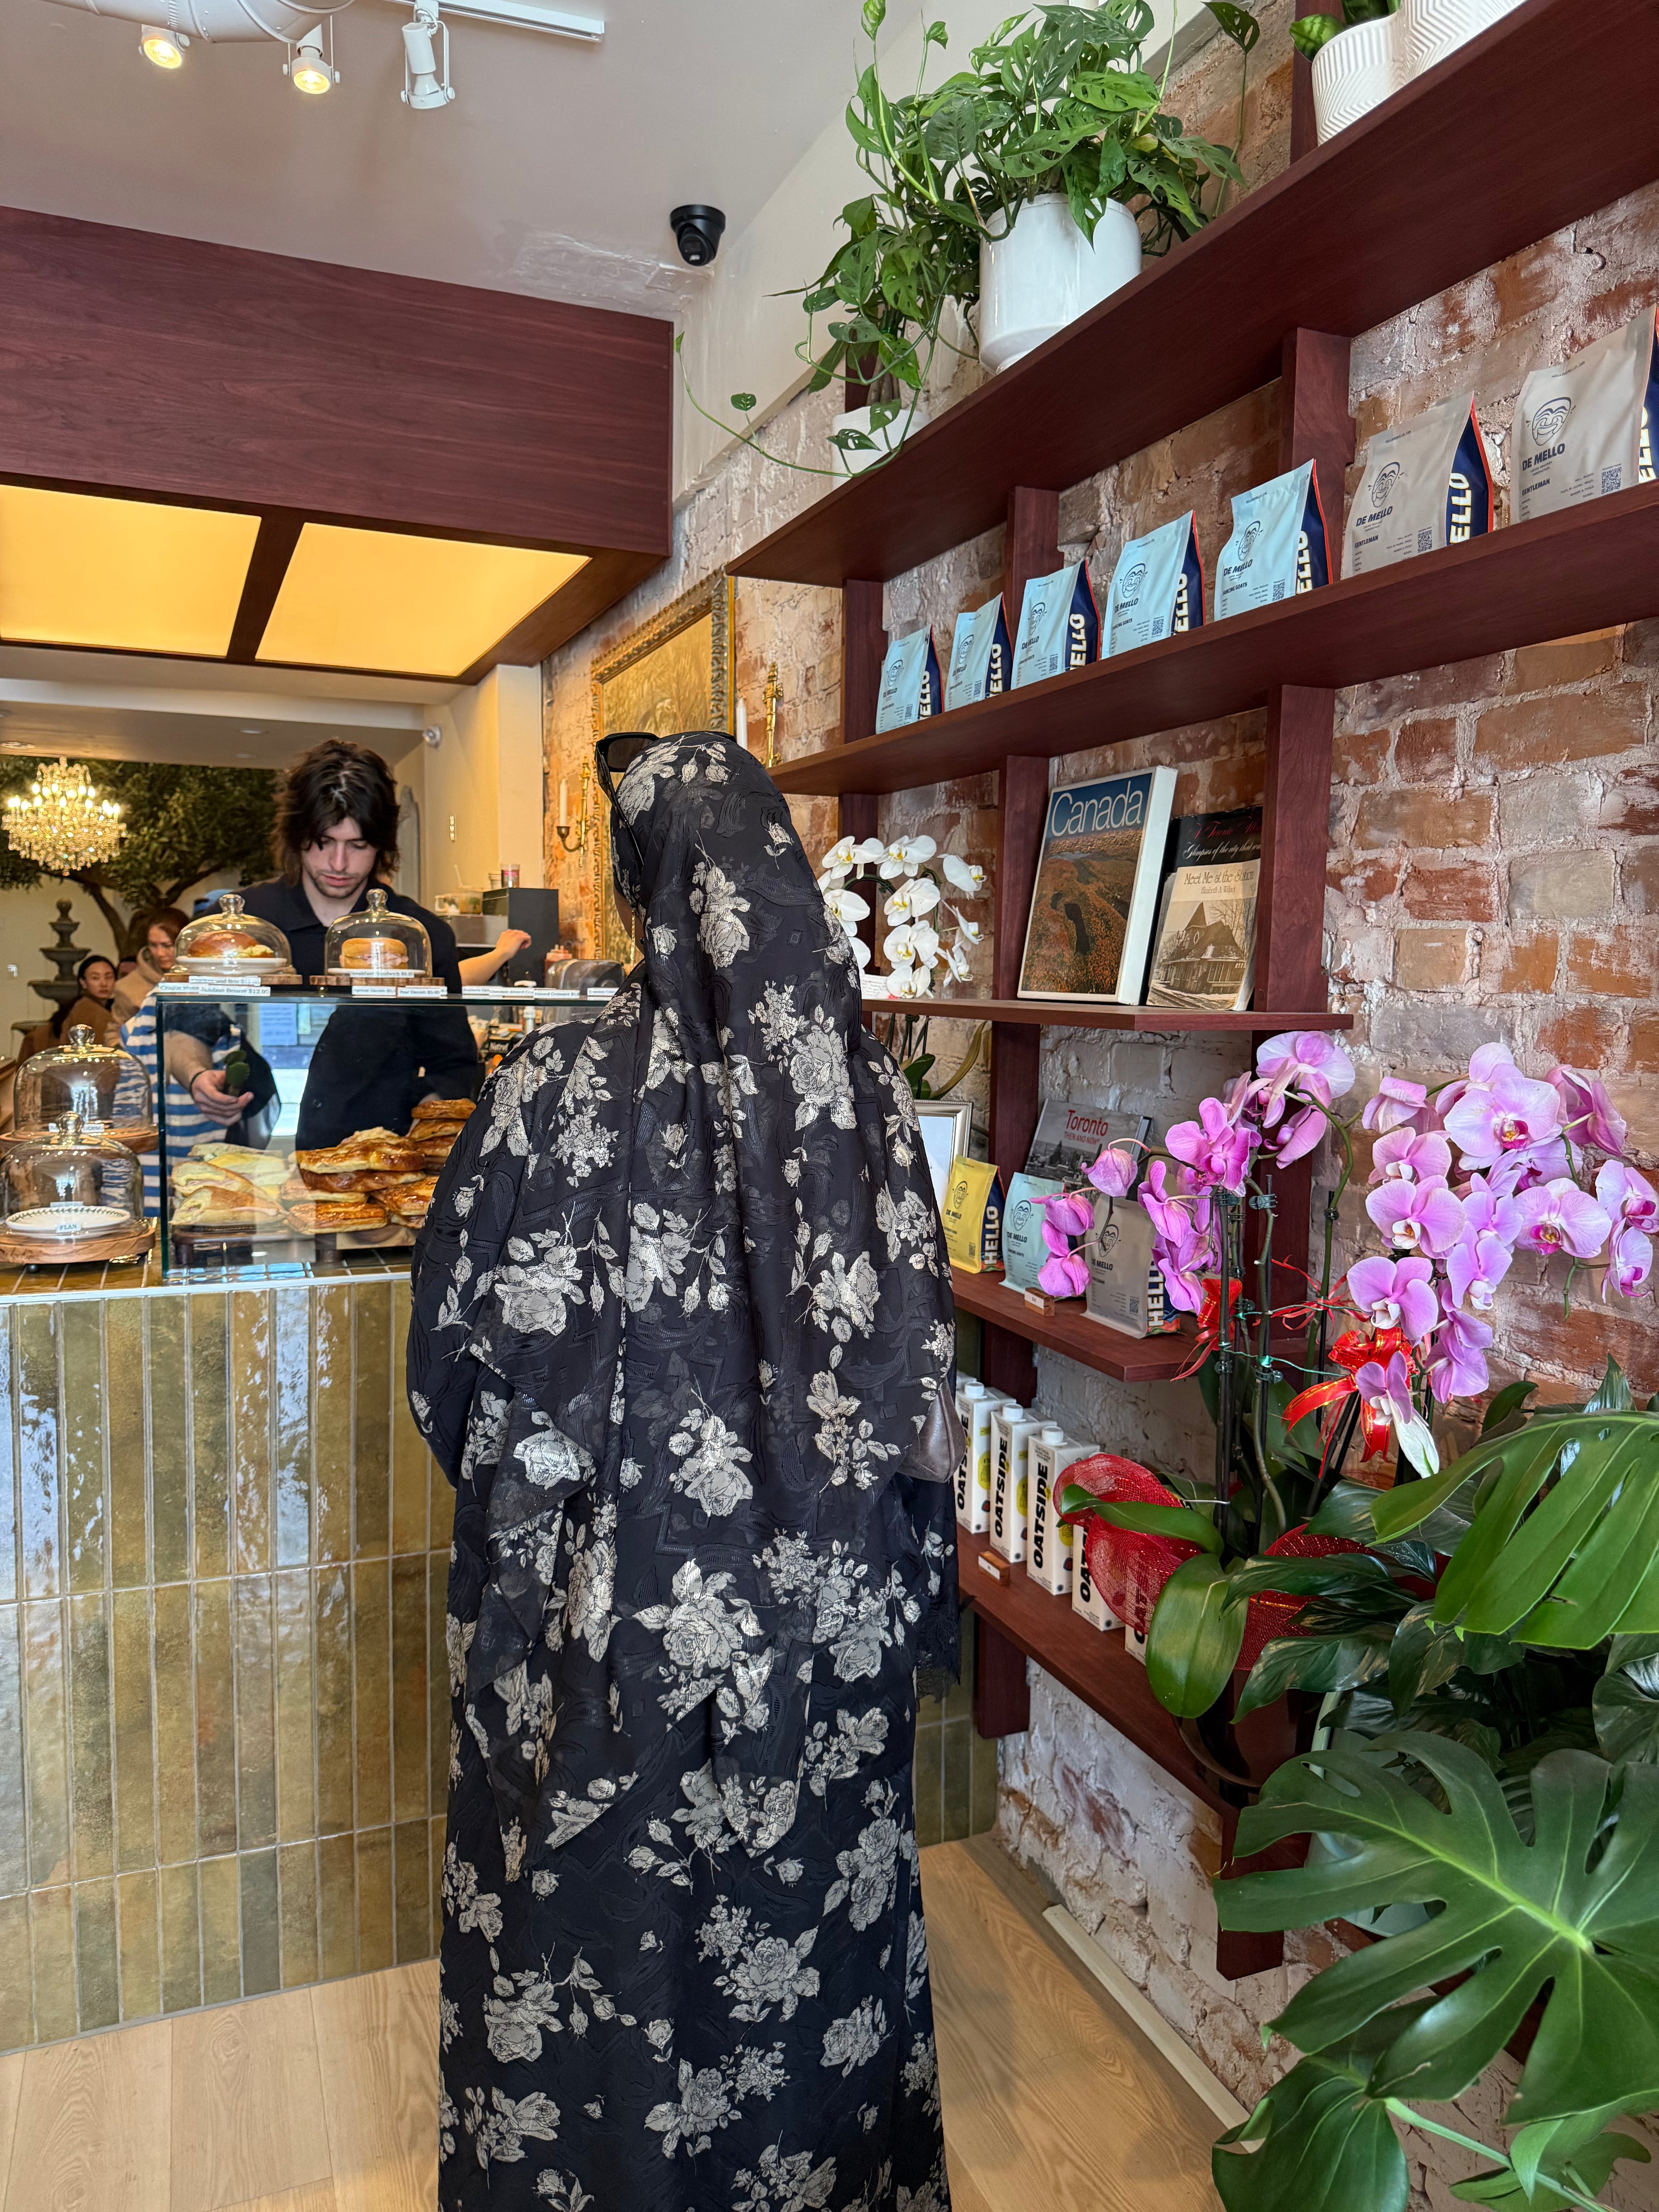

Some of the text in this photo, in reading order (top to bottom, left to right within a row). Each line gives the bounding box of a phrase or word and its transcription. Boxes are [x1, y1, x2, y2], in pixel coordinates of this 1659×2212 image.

[1522, 457, 1532, 471] DE
[1534, 443, 1566, 465] MELLO
[1522, 478, 1550, 496] GENTLEMAN
[1355, 516, 1366, 527] DE
[1367, 505, 1393, 523] MELLO
[1354, 535, 1379, 548] GENTLEMAN
[1223, 566, 1233, 577] DE
[1233, 559, 1253, 574] MELLO
[1235, 582, 1248, 591] GOATS
[1114, 604, 1120, 613] DE
[1120, 597, 1139, 610] MELLO
[1173, 573, 1189, 634] ELLO
[1069, 613, 1087, 670] ELLO
[989, 643, 1003, 697] ELLO
[919, 671, 931, 720] ELLO
[1051, 781, 1143, 837] Canada
[1204, 821, 1233, 839] Toronto
[1182, 842, 1211, 862] Glimpses
[1219, 841, 1230, 854] the
[1229, 843, 1239, 858] city
[1184, 868, 1254, 885] Meet Me at the Station
[1066, 1109, 1109, 1137] Toronto
[1064, 1131, 1076, 1141] THEN
[1076, 1134, 1086, 1143] AND
[984, 1206, 1000, 1265] HELLO
[1013, 1233, 1027, 1243] MELLO
[1096, 1259, 1113, 1271] MELLO
[1147, 1261, 1164, 1327] HELL
[995, 1437, 1007, 1538] OATSIDE
[1033, 1462, 1048, 1569] OATSIDE
